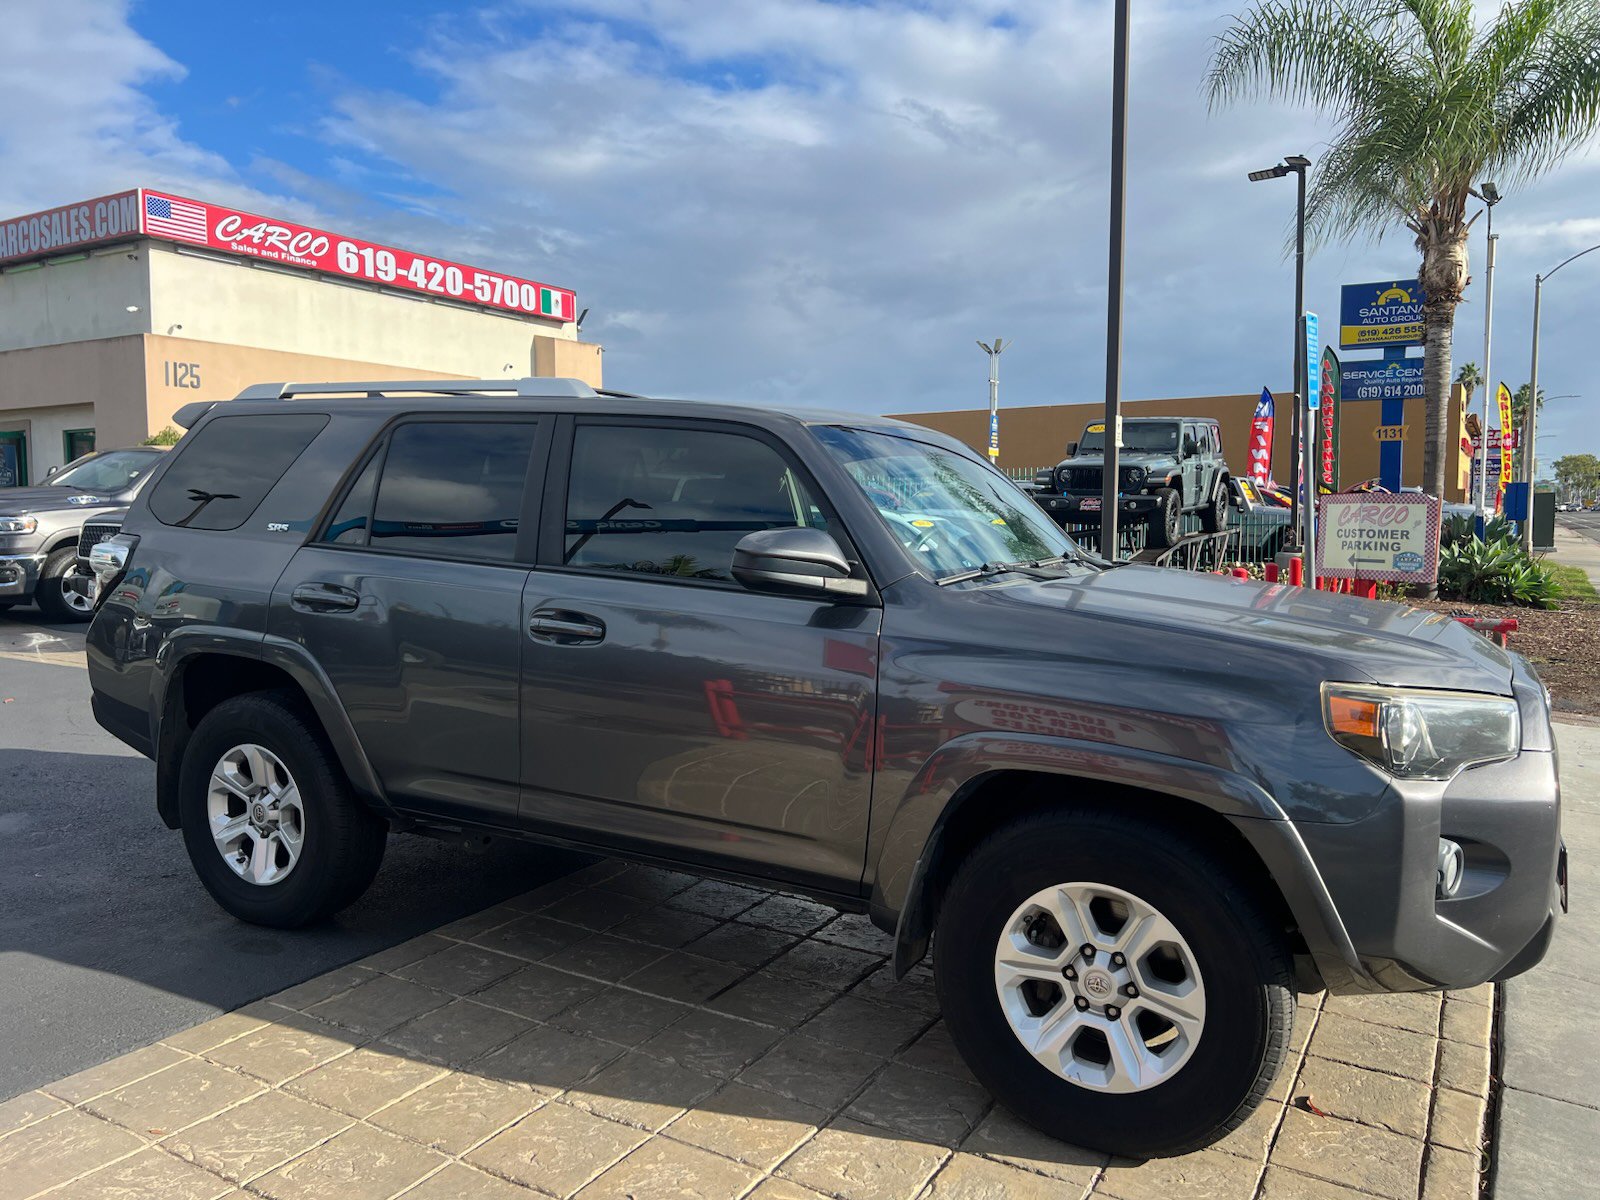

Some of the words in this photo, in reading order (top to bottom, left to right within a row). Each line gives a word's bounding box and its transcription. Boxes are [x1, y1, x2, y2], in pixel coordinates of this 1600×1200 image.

[215, 215, 330, 257] CARCO
[231, 242, 259, 255] Sales
[261, 249, 279, 259] and
[281, 252, 318, 267] Finance
[336, 240, 537, 312] 619-420-5700
[1362, 317, 1389, 325] AUTO
[1357, 328, 1380, 338] (619)
[1382, 327, 1402, 335] 426
[164, 360, 201, 389] 1125
[1342, 369, 1394, 380] SERVICE
[1357, 386, 1382, 399] (619)
[1384, 385, 1402, 397] 614
[1403, 383, 1426, 397] 200
[1376, 428, 1403, 439] 1131
[1337, 505, 1410, 527] CARCO
[1336, 528, 1410, 540] CUSTOMER
[1341, 540, 1402, 552] PARKING
